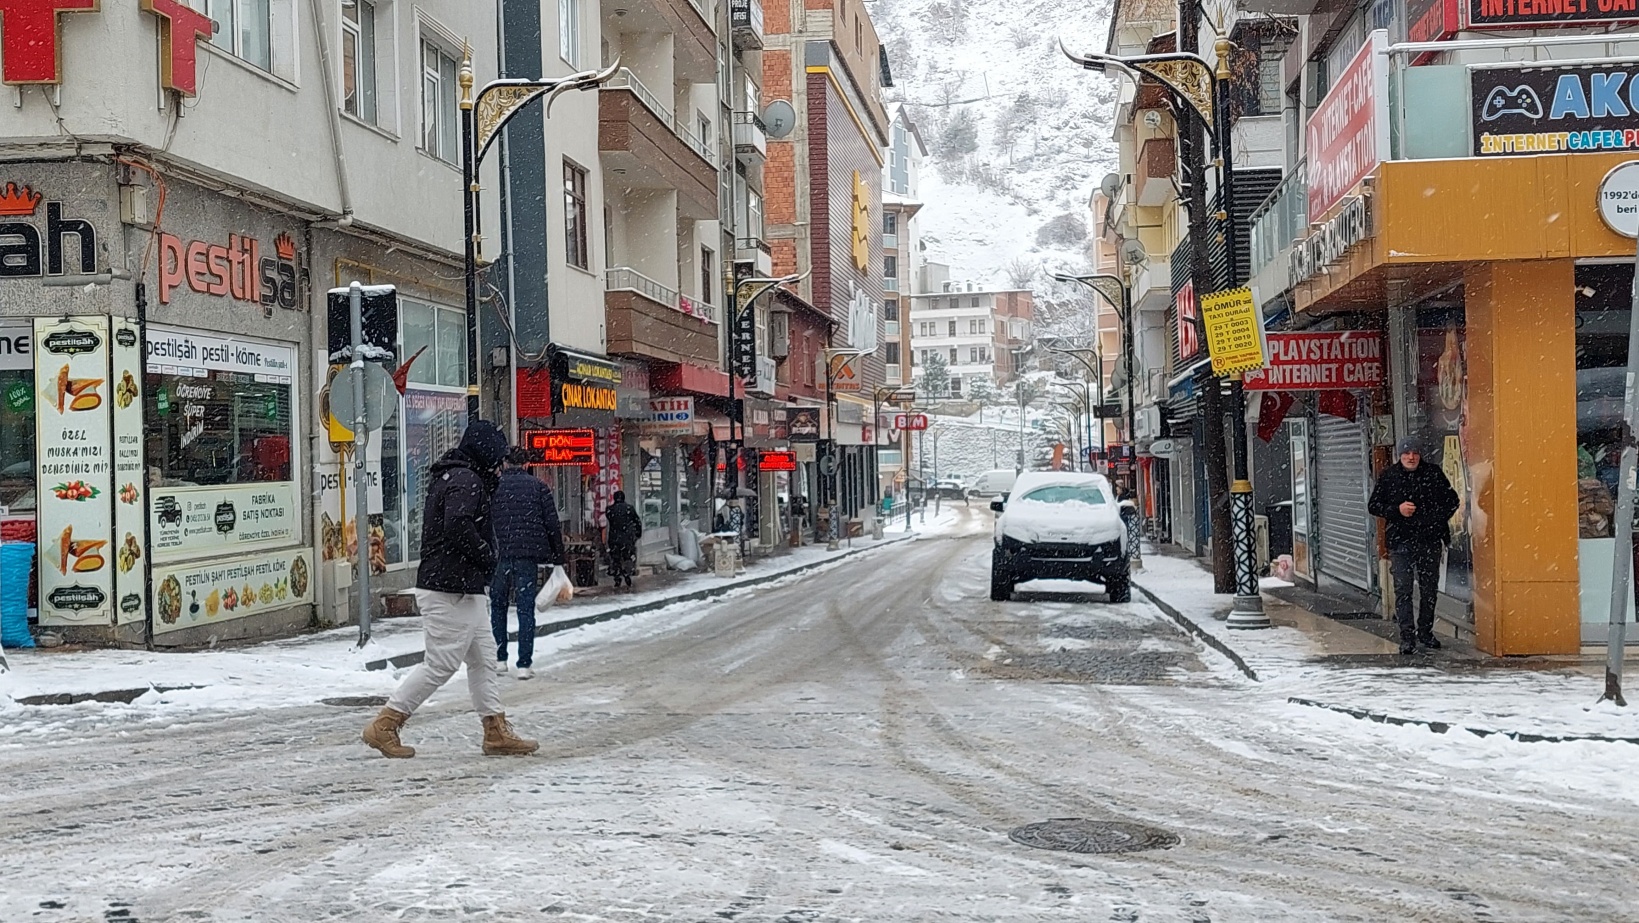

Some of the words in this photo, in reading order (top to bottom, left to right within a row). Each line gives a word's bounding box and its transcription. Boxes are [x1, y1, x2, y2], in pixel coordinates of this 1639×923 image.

[1550, 72, 1639, 119] AK
[1616, 204, 1638, 214] beri
[0, 201, 96, 276] ah
[1214, 299, 1241, 311] ÖMÜR
[1343, 363, 1381, 382] CAFE
[562, 383, 582, 414] ÇINAR
[583, 387, 617, 411] LOKANTASI
[650, 399, 689, 412] ATİH
[898, 415, 924, 428] BM
[62, 428, 87, 440] ÖZEL
[533, 436, 547, 448] ET
[252, 492, 275, 505] FABRİKA
[243, 510, 259, 523] SATIŞ
[260, 507, 285, 518] NOKTASI
[185, 569, 210, 586] PESTİLİN
[227, 564, 254, 581] PESTİLŞAH
[256, 560, 272, 575] PESTİL
[273, 558, 286, 572] KÖME
